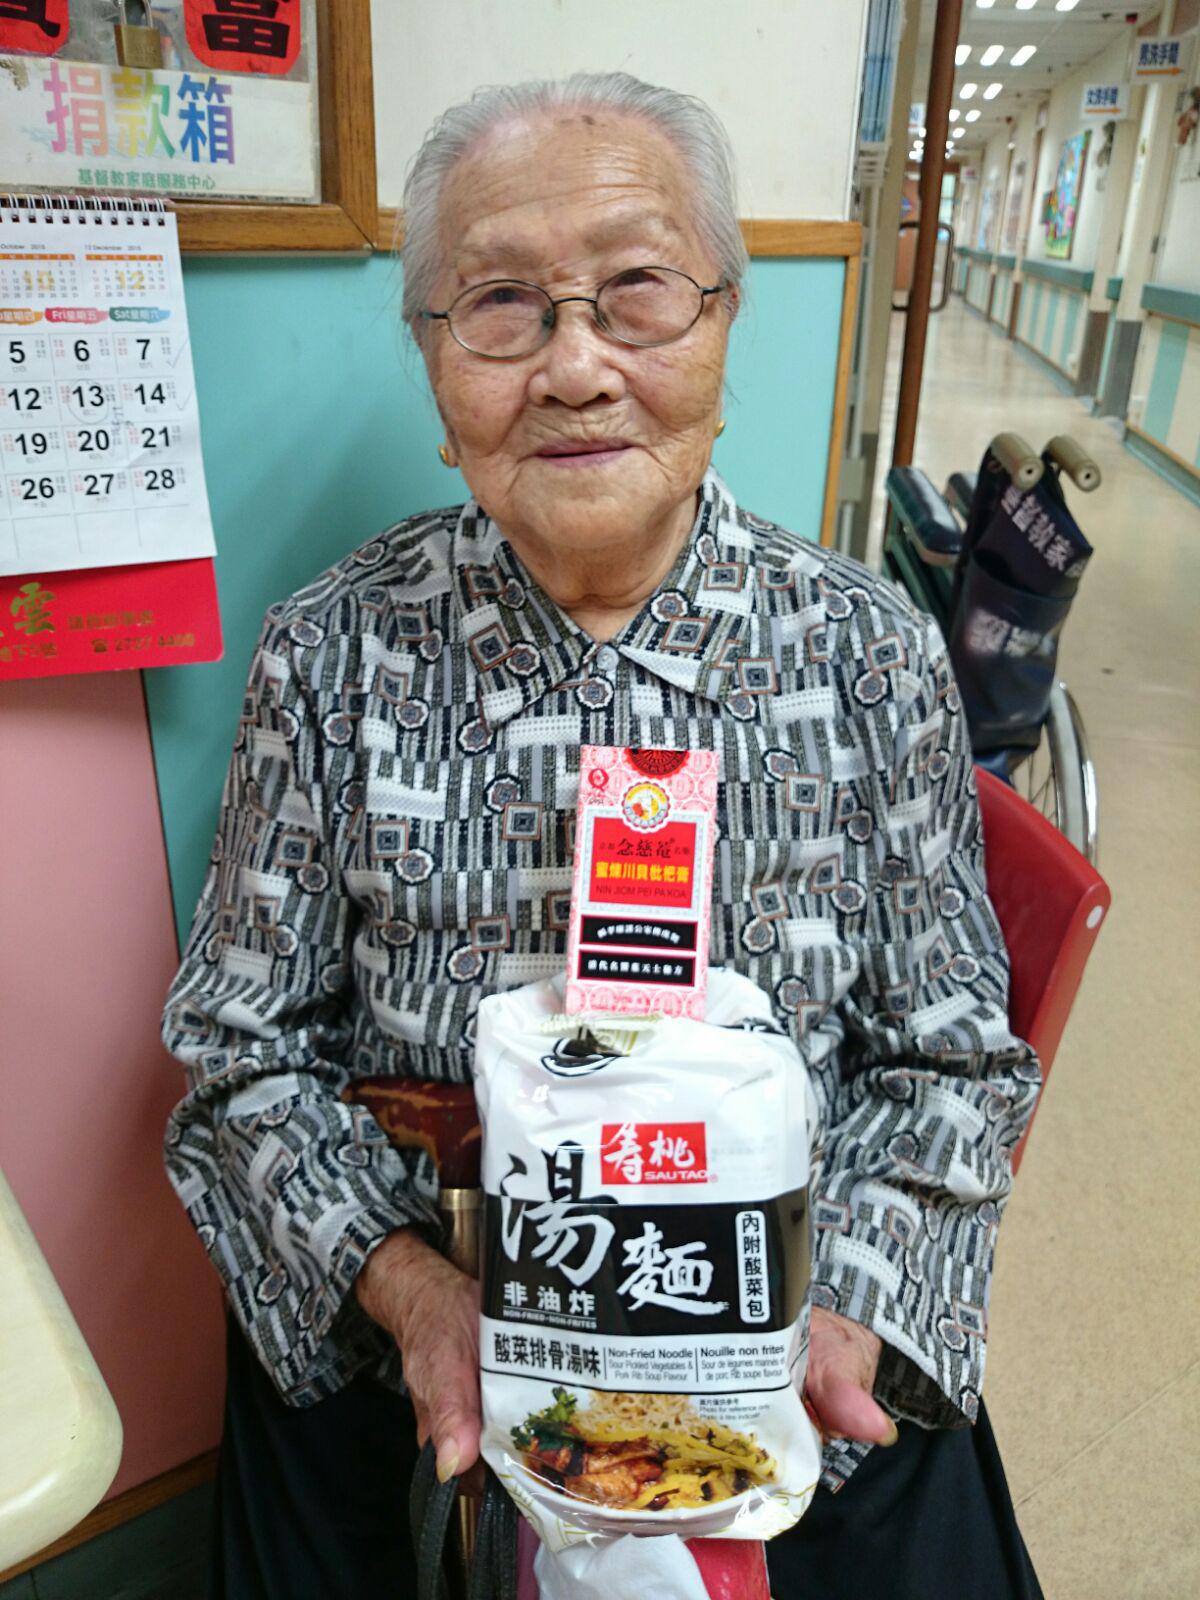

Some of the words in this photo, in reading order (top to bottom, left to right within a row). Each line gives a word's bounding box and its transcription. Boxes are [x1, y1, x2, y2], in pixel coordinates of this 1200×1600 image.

[43, 61, 236, 165] 捐款箱
[78, 168, 217, 191] 基督教家庭服務中心
[9, 341, 26, 364] 5
[73, 339, 90, 362] 6
[136, 338, 151, 361] 7
[8, 388, 42, 411] 12
[72, 385, 105, 408] 13
[134, 383, 166, 405] 14
[15, 432, 48, 455] 19
[77, 429, 110, 452] 20
[141, 427, 170, 448] 21
[21, 477, 54, 500] 26
[84, 473, 115, 496] 27
[144, 468, 175, 491] 28
[596, 885, 611, 895] NIN
[503, 1280, 596, 1316] 非油炸
[494, 1332, 601, 1379] 酸菜排骨湯味
[608, 1348, 655, 1359] Non-Fried
[658, 1348, 693, 1359] Noodle
[700, 1347, 736, 1358] Nouille
[738, 1347, 759, 1357] non
[762, 1345, 785, 1356] frites
[608, 1360, 624, 1370] Sour
[651, 1361, 687, 1372] Vegetables
[687, 1361, 693, 1370] &
[615, 1371, 630, 1380] Pork
[644, 1371, 662, 1382] Soup
[663, 1372, 688, 1381] Flavour
[701, 1360, 716, 1370] Sour
[717, 1360, 726, 1369] de
[705, 1372, 714, 1382] de
[742, 1370, 762, 1382] soupe
